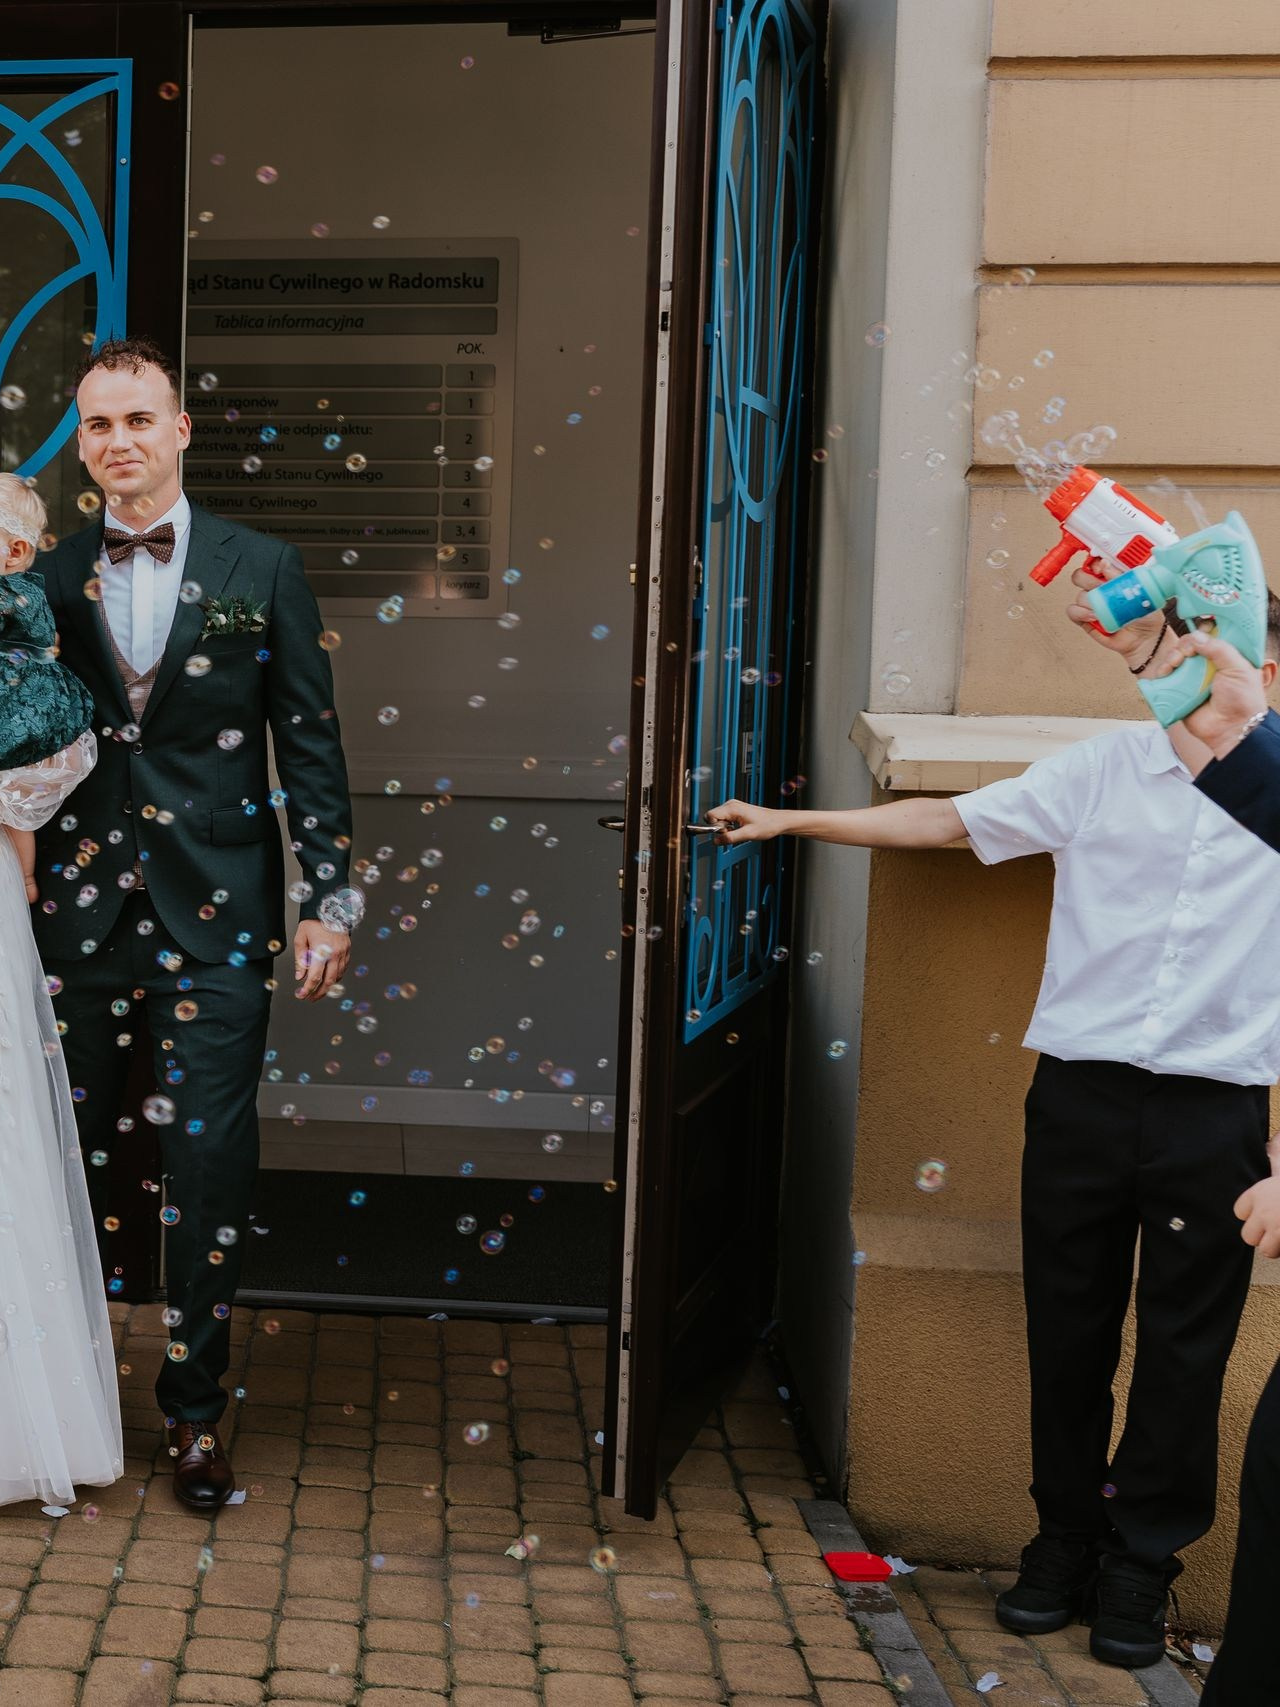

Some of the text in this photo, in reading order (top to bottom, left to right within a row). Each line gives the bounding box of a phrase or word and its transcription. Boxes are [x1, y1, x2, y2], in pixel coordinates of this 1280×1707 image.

[212, 273, 265, 290] Stanu
[269, 273, 364, 294] Cywilnego
[367, 277, 385, 289] w
[388, 272, 485, 289] Radomsku
[214, 314, 365, 332] Tablica informacyjna
[456, 343, 486, 355] POK.
[227, 396, 279, 410] zgonów
[293, 423, 337, 438] odpisu
[465, 433, 473, 445] 2
[244, 442, 285, 454] zgonu
[225, 468, 272, 483] Urzędu
[274, 468, 311, 481] Stanu
[315, 468, 384, 483] Cywilnego
[464, 470, 471, 482] 3
[207, 496, 243, 508] Stanu
[249, 496, 318, 510] Cywilnego
[462, 498, 470, 508] 4
[468, 526, 476, 537] 4
[462, 554, 469, 564] 5
